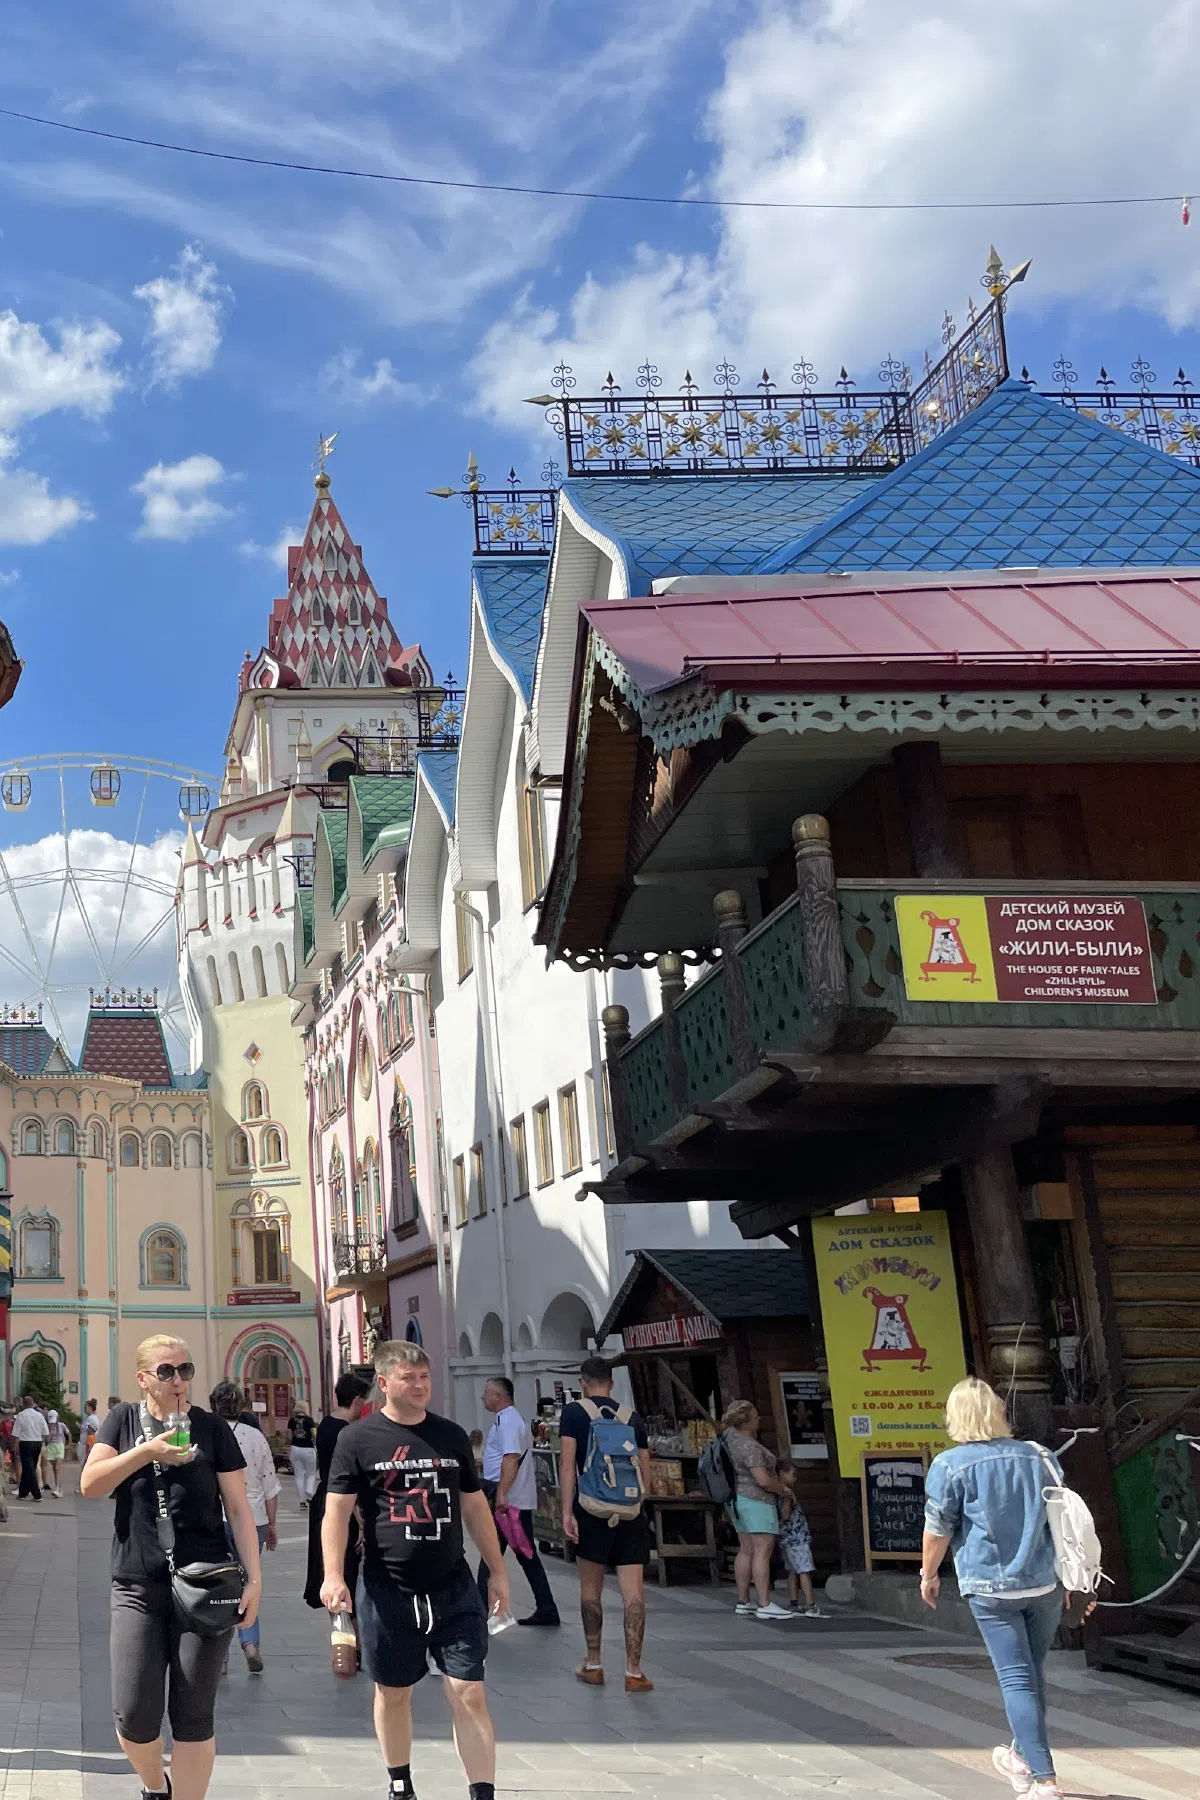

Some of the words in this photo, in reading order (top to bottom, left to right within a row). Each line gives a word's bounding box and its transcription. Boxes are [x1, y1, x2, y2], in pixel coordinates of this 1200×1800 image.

[1000, 901, 1069, 916] ДЕТСКИЙ
[1074, 901, 1125, 915] МУЗЕЙ
[1016, 919, 1051, 932] ДОМ
[1055, 919, 1115, 932] СКАЗОК
[998, 941, 1144, 957] «ЖИЛИ-БЫЛИ»
[1006, 965, 1027, 975] THE
[1028, 965, 1064, 975] HOUSE
[1065, 965, 1079, 975] OF
[1080, 965, 1140, 976] FAIRY-TALES
[1045, 976, 1106, 986] «ZHILI-BYLI»
[1024, 987, 1082, 997] CHILDREN'S
[1084, 987, 1129, 998] MUSEUM
[828, 1239, 863, 1253] ДОМ
[869, 1235, 937, 1249] СКАЗОК
[863, 1389, 935, 1397] ежедневно
[862, 1402, 894, 1410] 10.00
[898, 1402, 913, 1410] до
[877, 1422, 947, 1430] domskazok.
[875, 1441, 893, 1449] 495
[917, 1441, 931, 1450] 95
[209, 1597, 241, 1605] BALENCIA
